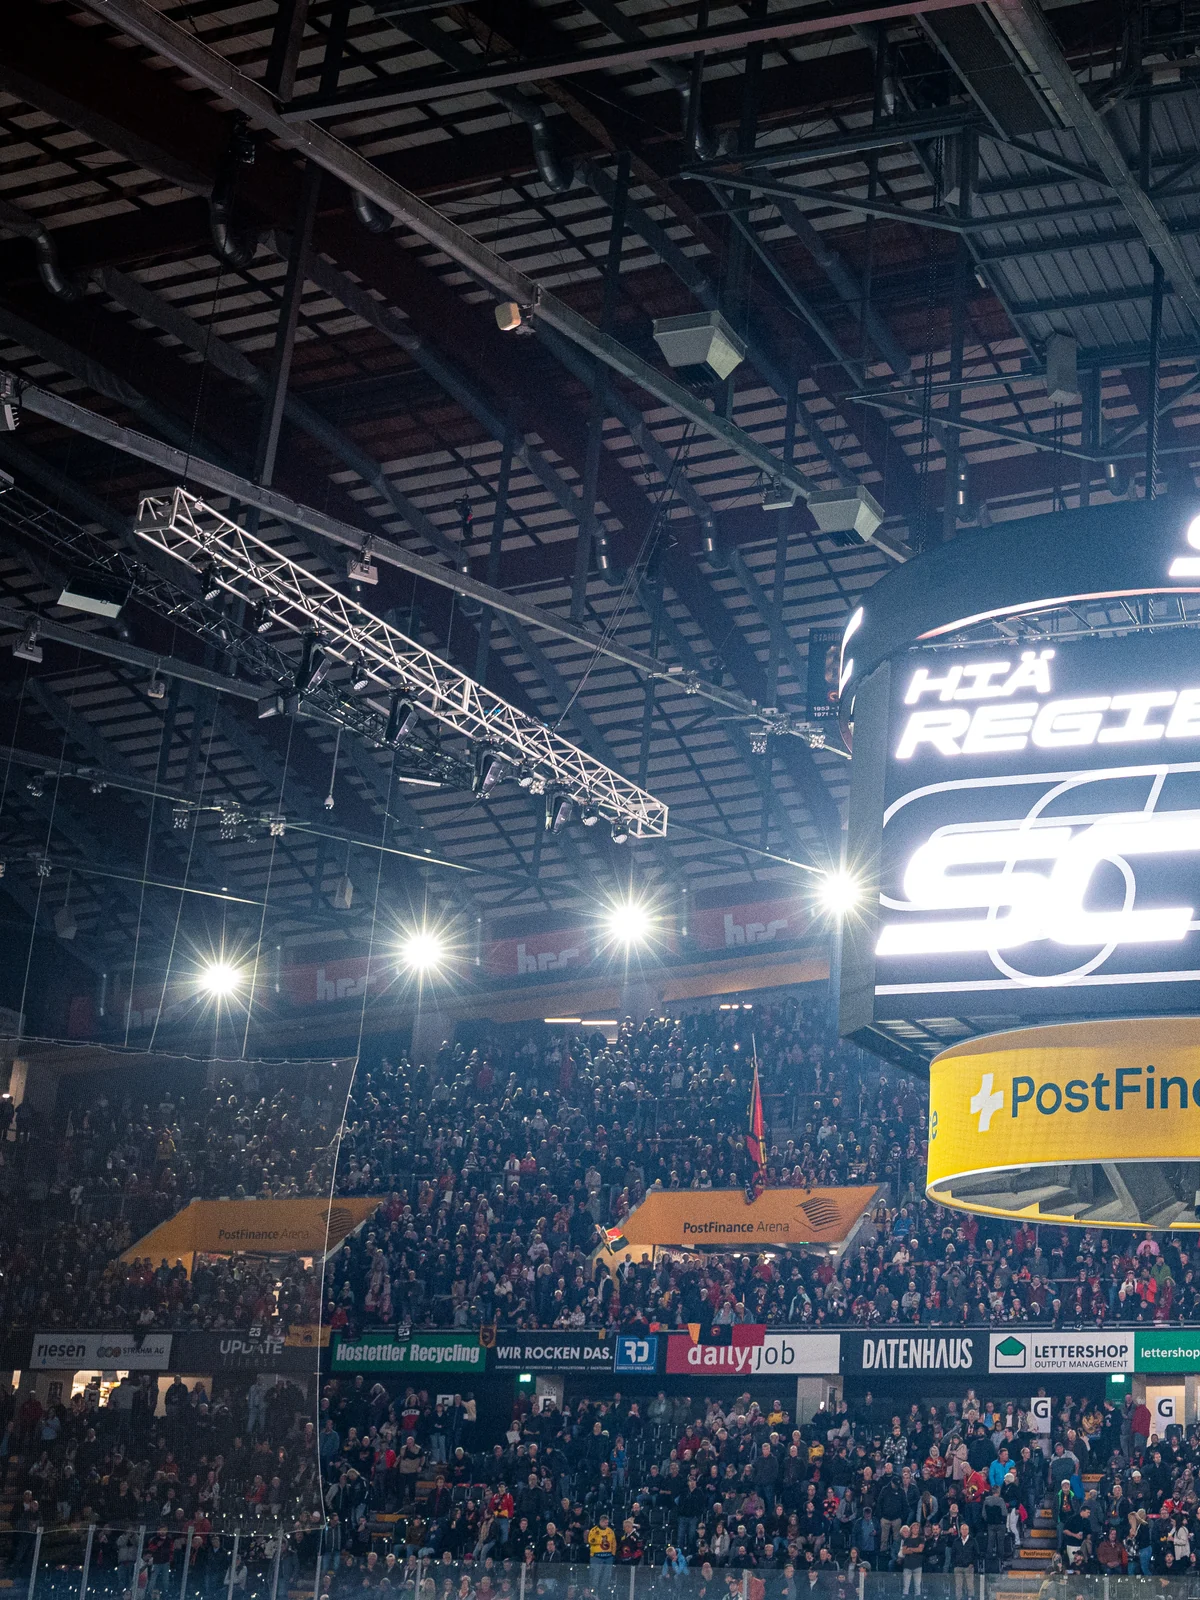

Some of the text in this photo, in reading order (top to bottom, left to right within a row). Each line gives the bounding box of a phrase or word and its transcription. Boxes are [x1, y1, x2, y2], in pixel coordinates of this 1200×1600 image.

[903, 650, 1056, 705] HIÄ
[218, 1228, 309, 1240] PostFinance Arena
[683, 1221, 790, 1234] PostFinance Arena
[37, 1344, 86, 1358] riesen
[154, 1347, 165, 1355] AG
[336, 1344, 480, 1364] Hostettler Recycling
[496, 1346, 613, 1360] WIR ROCKEN DAS.
[862, 1338, 973, 1369] DATENHAUS
[1035, 1345, 1128, 1358] LETTERSHOP
[1035, 1360, 1128, 1368] OUTPUT MANAGEMENT
[1033, 1400, 1048, 1418] G
[1158, 1399, 1173, 1417] G
